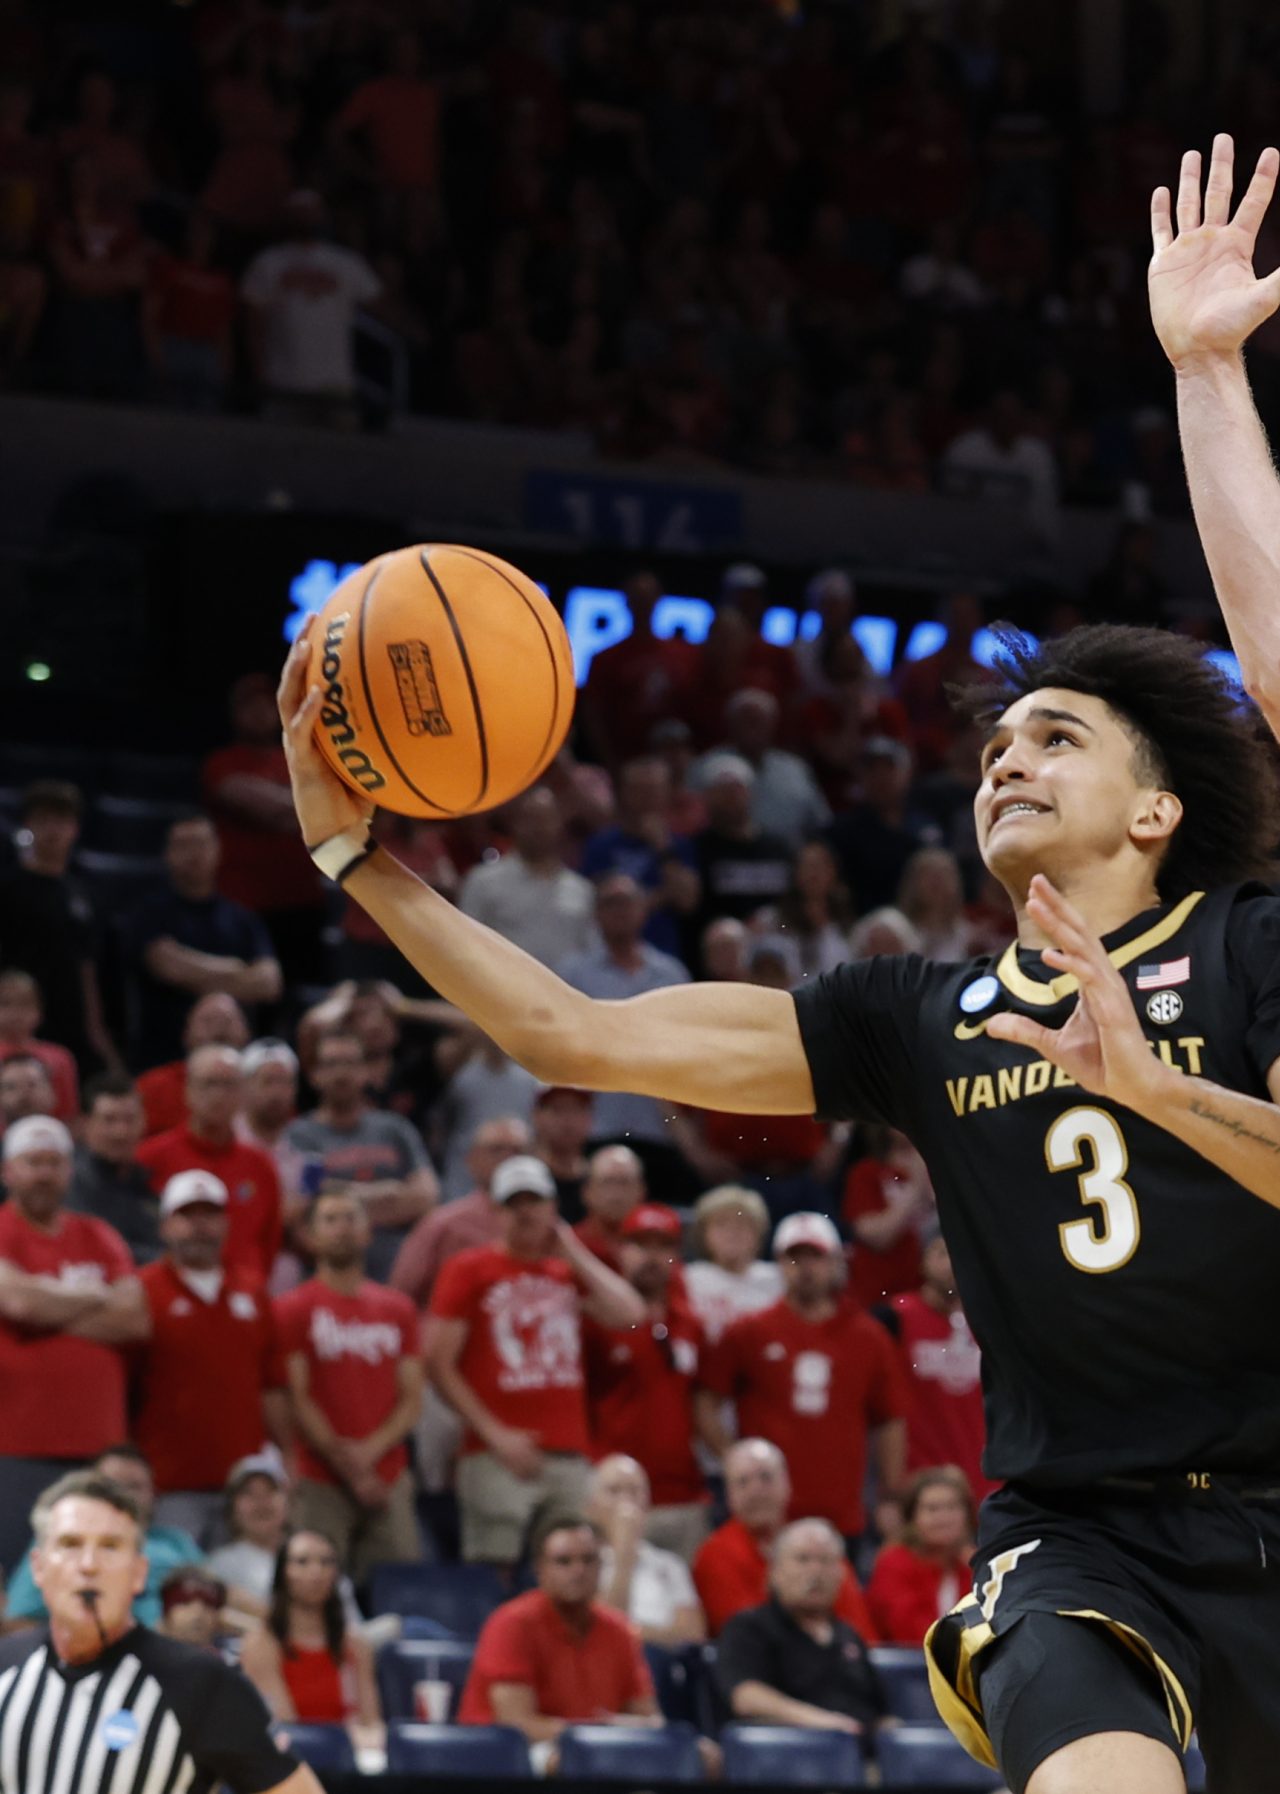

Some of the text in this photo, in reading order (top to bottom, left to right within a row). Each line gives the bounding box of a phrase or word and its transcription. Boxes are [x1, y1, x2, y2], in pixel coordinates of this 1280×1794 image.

[322, 611, 386, 793] Wilson
[1150, 993, 1180, 1022] SEC
[945, 1036, 1205, 1117] VANDLT
[1044, 1104, 1141, 1275] 3
